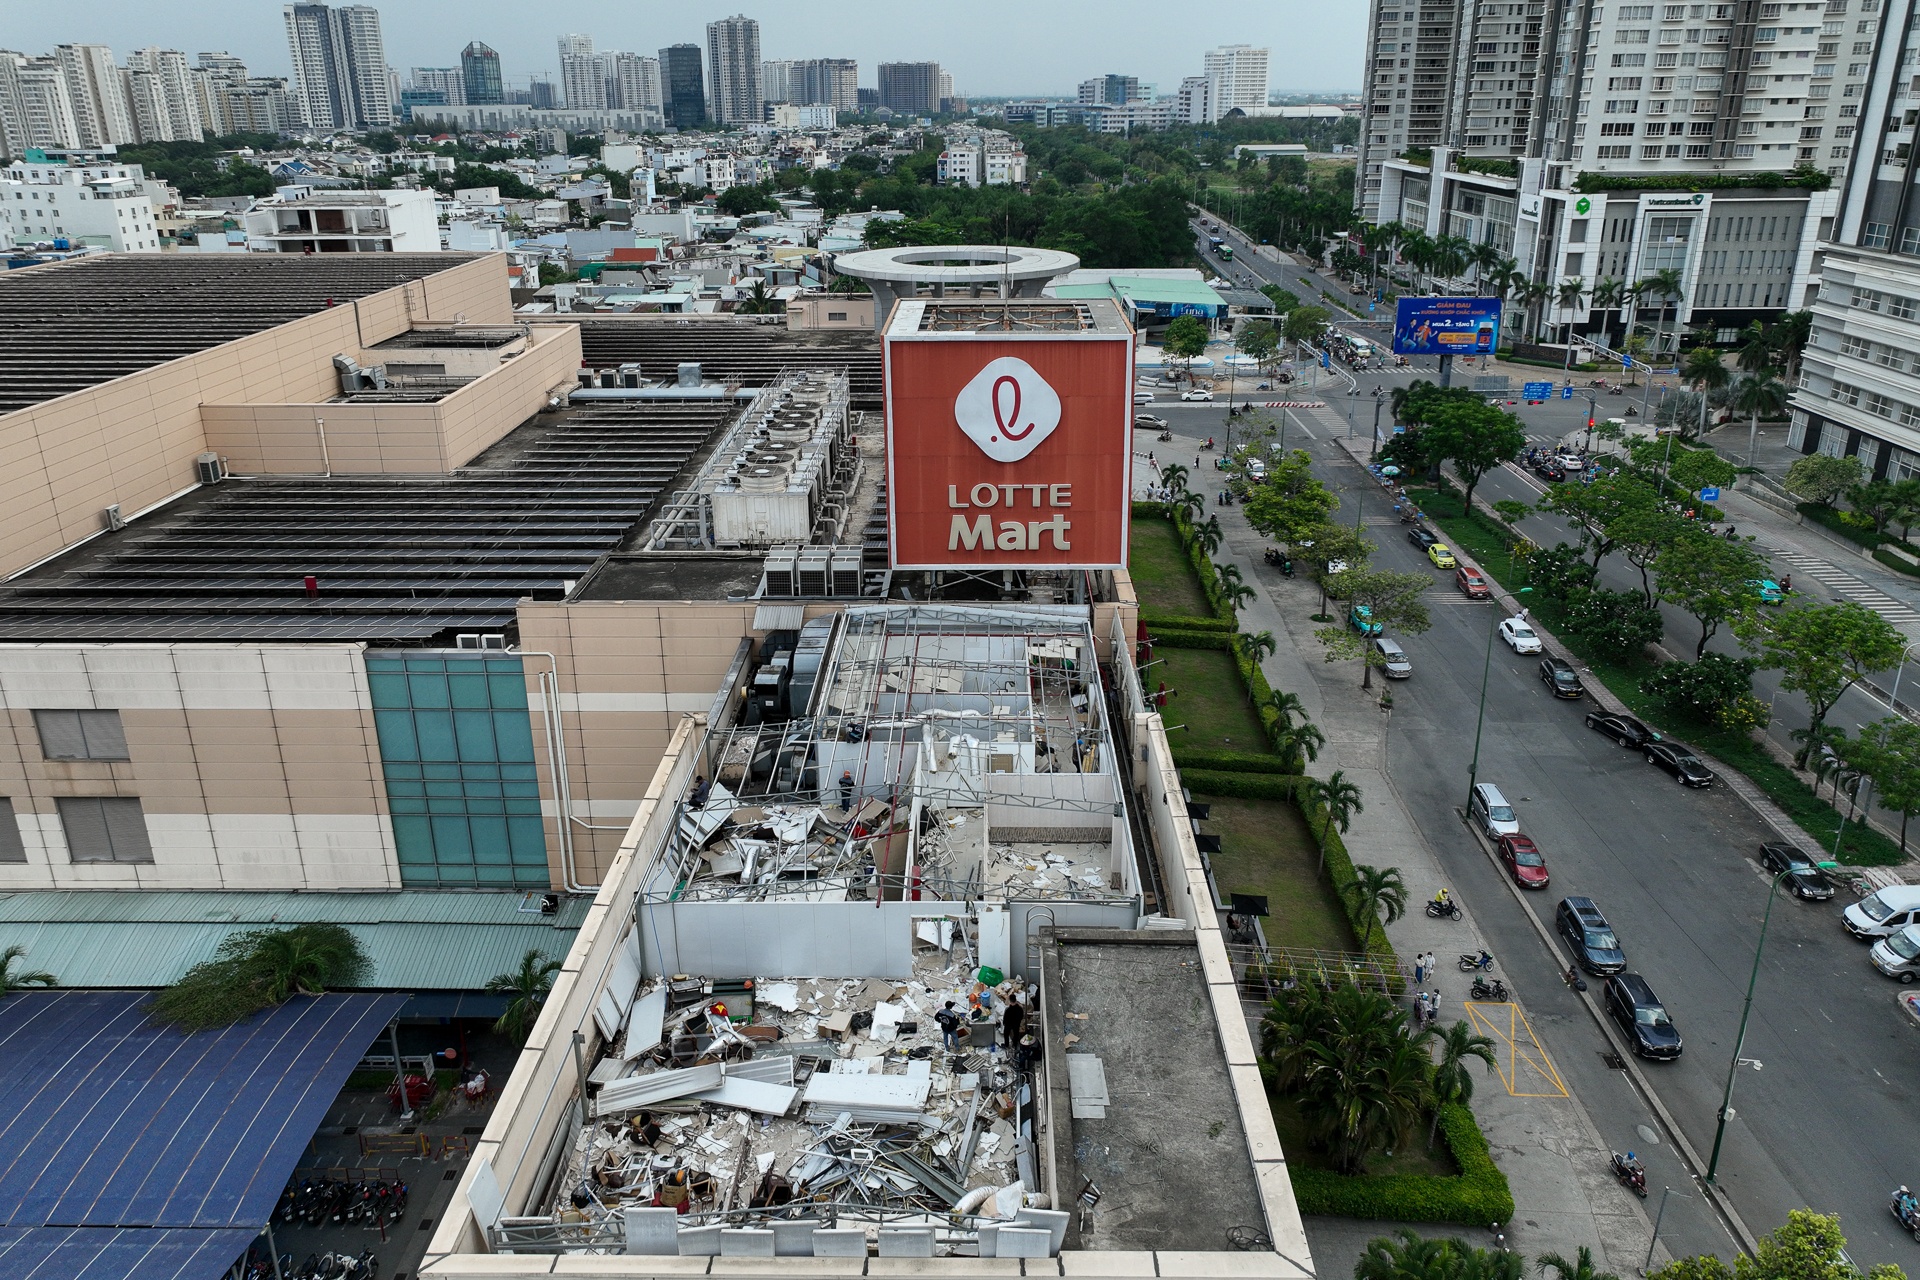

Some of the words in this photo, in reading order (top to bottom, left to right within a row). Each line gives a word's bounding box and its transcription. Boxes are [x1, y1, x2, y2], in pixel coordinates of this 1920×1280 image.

[1444, 319, 1452, 327] 2
[1469, 319, 1474, 327] 1
[948, 482, 1072, 508] LOTTE
[948, 514, 1071, 551] Mart
